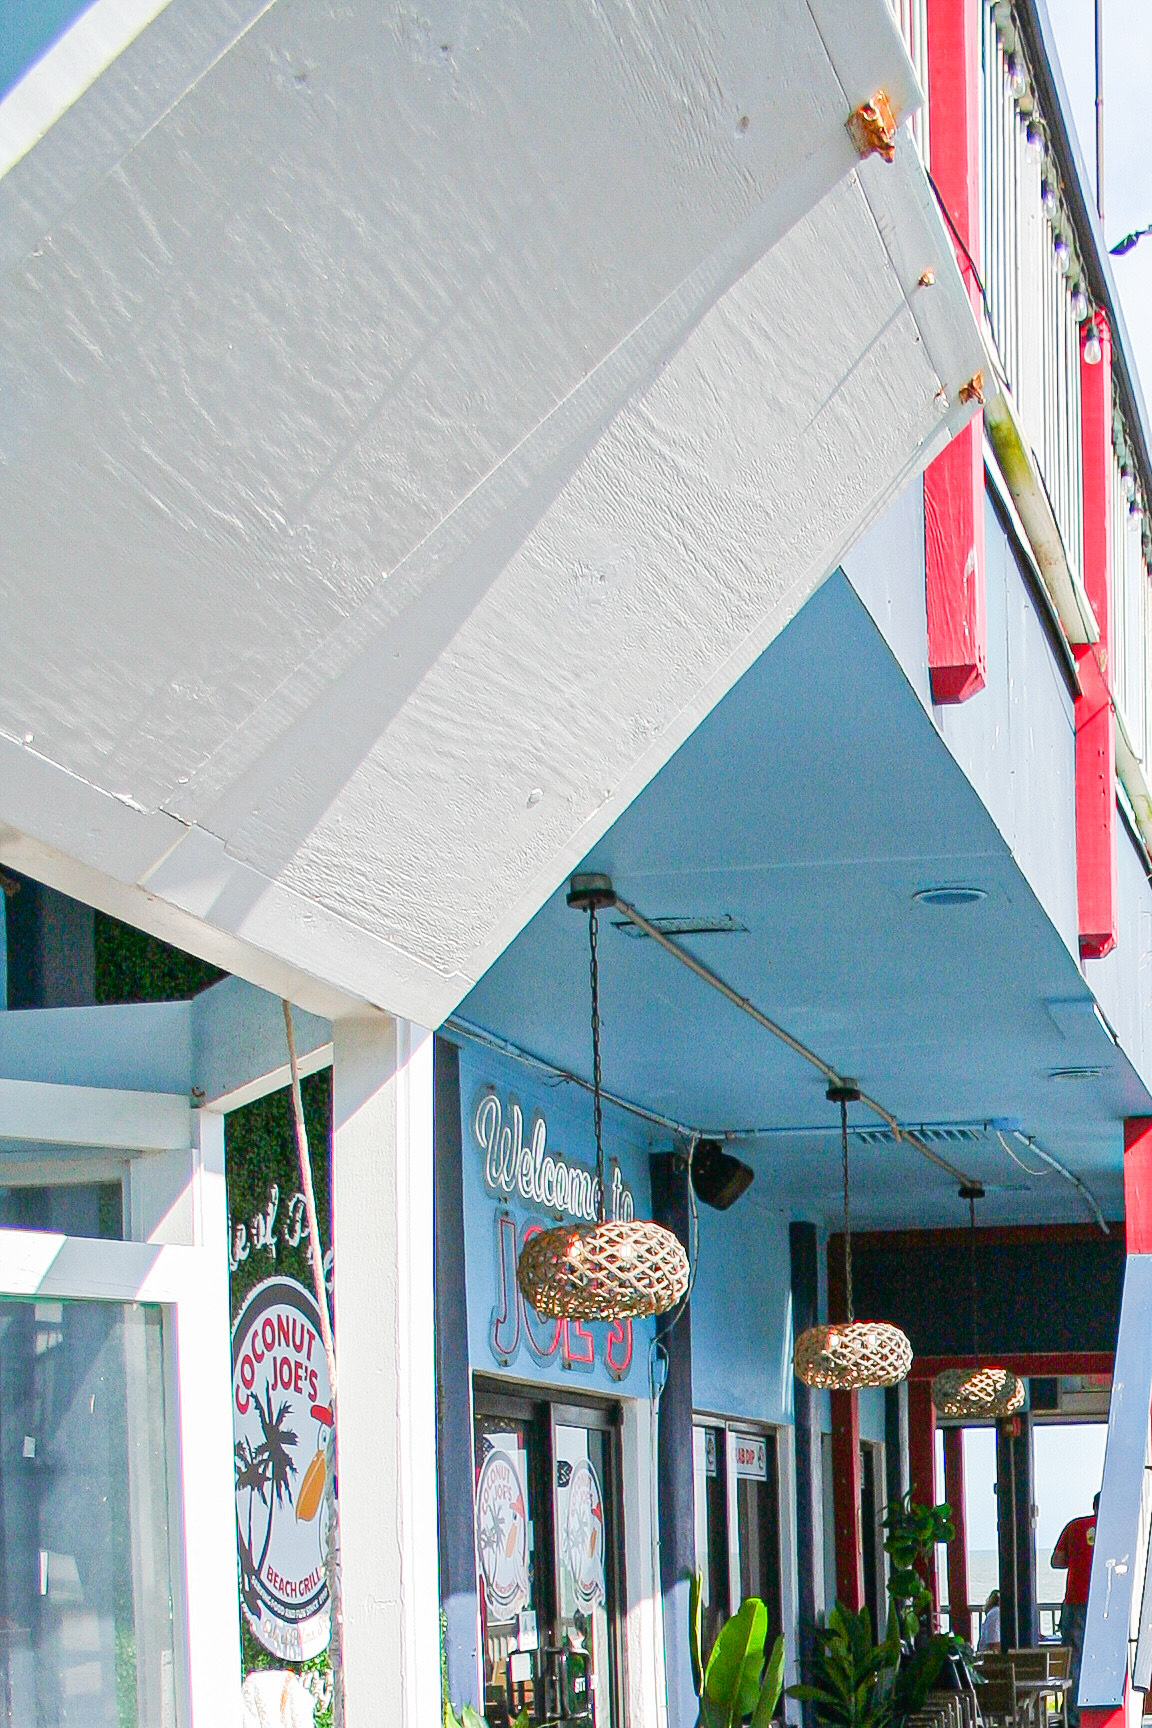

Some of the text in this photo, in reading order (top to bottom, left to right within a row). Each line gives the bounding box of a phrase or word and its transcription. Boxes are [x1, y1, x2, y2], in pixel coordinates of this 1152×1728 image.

[475, 1094, 604, 1224] Welcome
[235, 1314, 316, 1416] COCONUT
[271, 1356, 317, 1403] JOE'S
[266, 1564, 297, 1599] BEACH
[299, 1566, 321, 1597] GRILL
